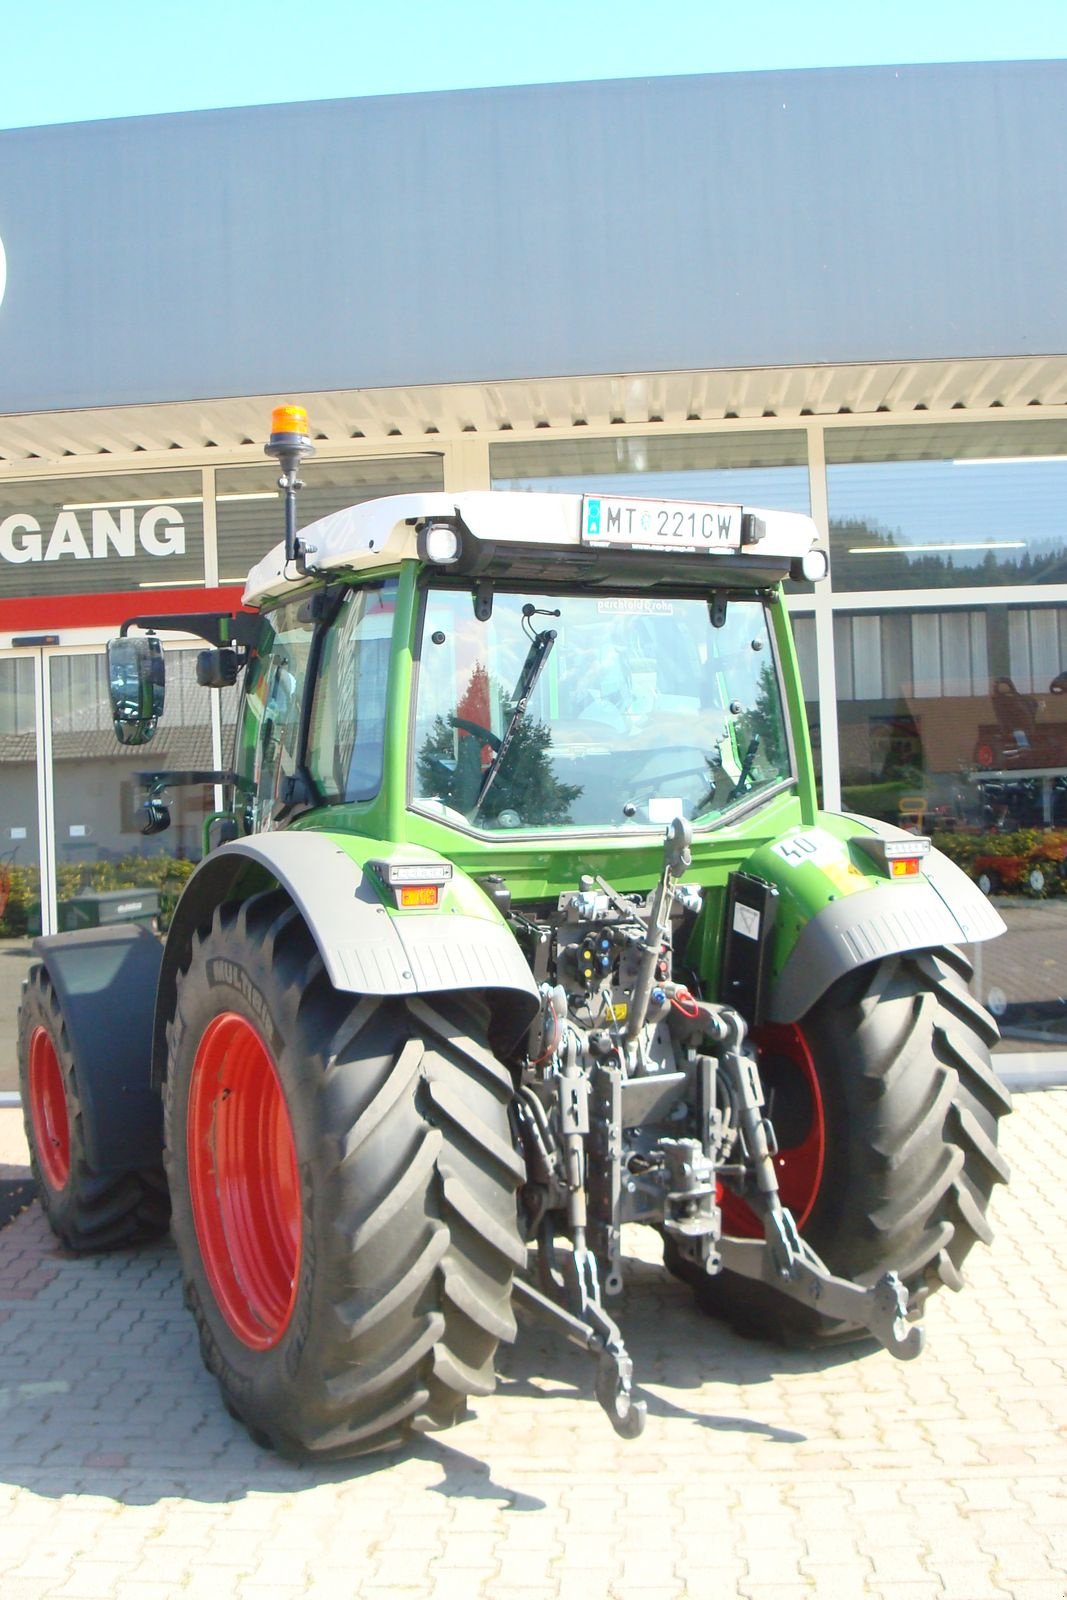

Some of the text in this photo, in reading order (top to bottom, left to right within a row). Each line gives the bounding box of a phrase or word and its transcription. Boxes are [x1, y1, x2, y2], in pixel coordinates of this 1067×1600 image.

[0, 506, 185, 563] GANG
[607, 507, 731, 539] MT 221CW
[780, 838, 817, 858] 40
